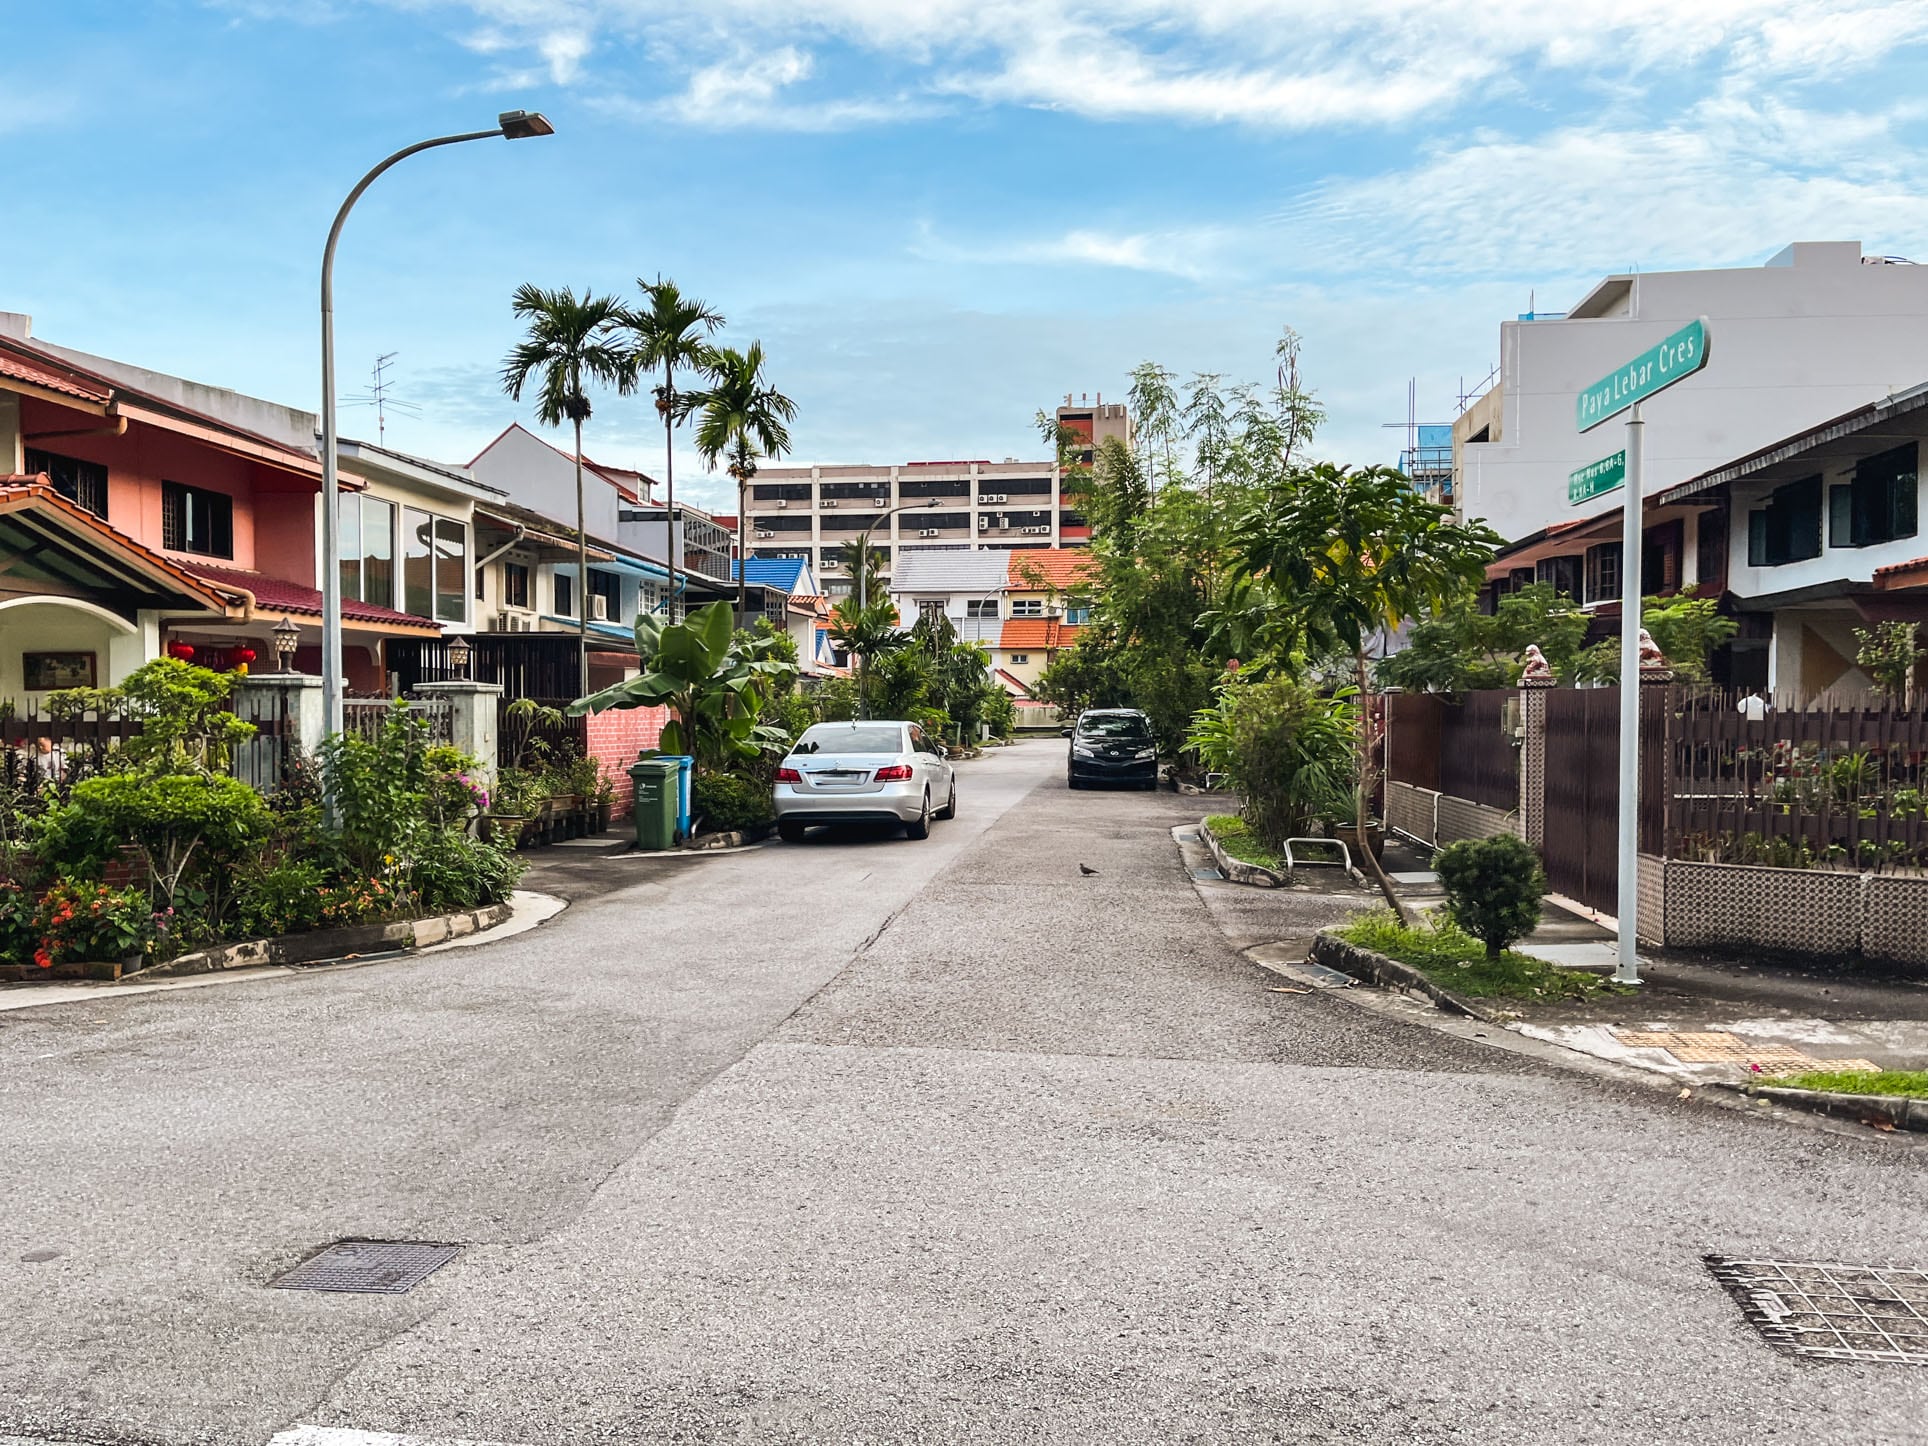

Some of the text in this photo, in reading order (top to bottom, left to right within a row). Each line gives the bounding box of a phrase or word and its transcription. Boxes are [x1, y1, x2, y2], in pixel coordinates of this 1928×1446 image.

[1582, 336, 1694, 418] Paya Lebar Cres
